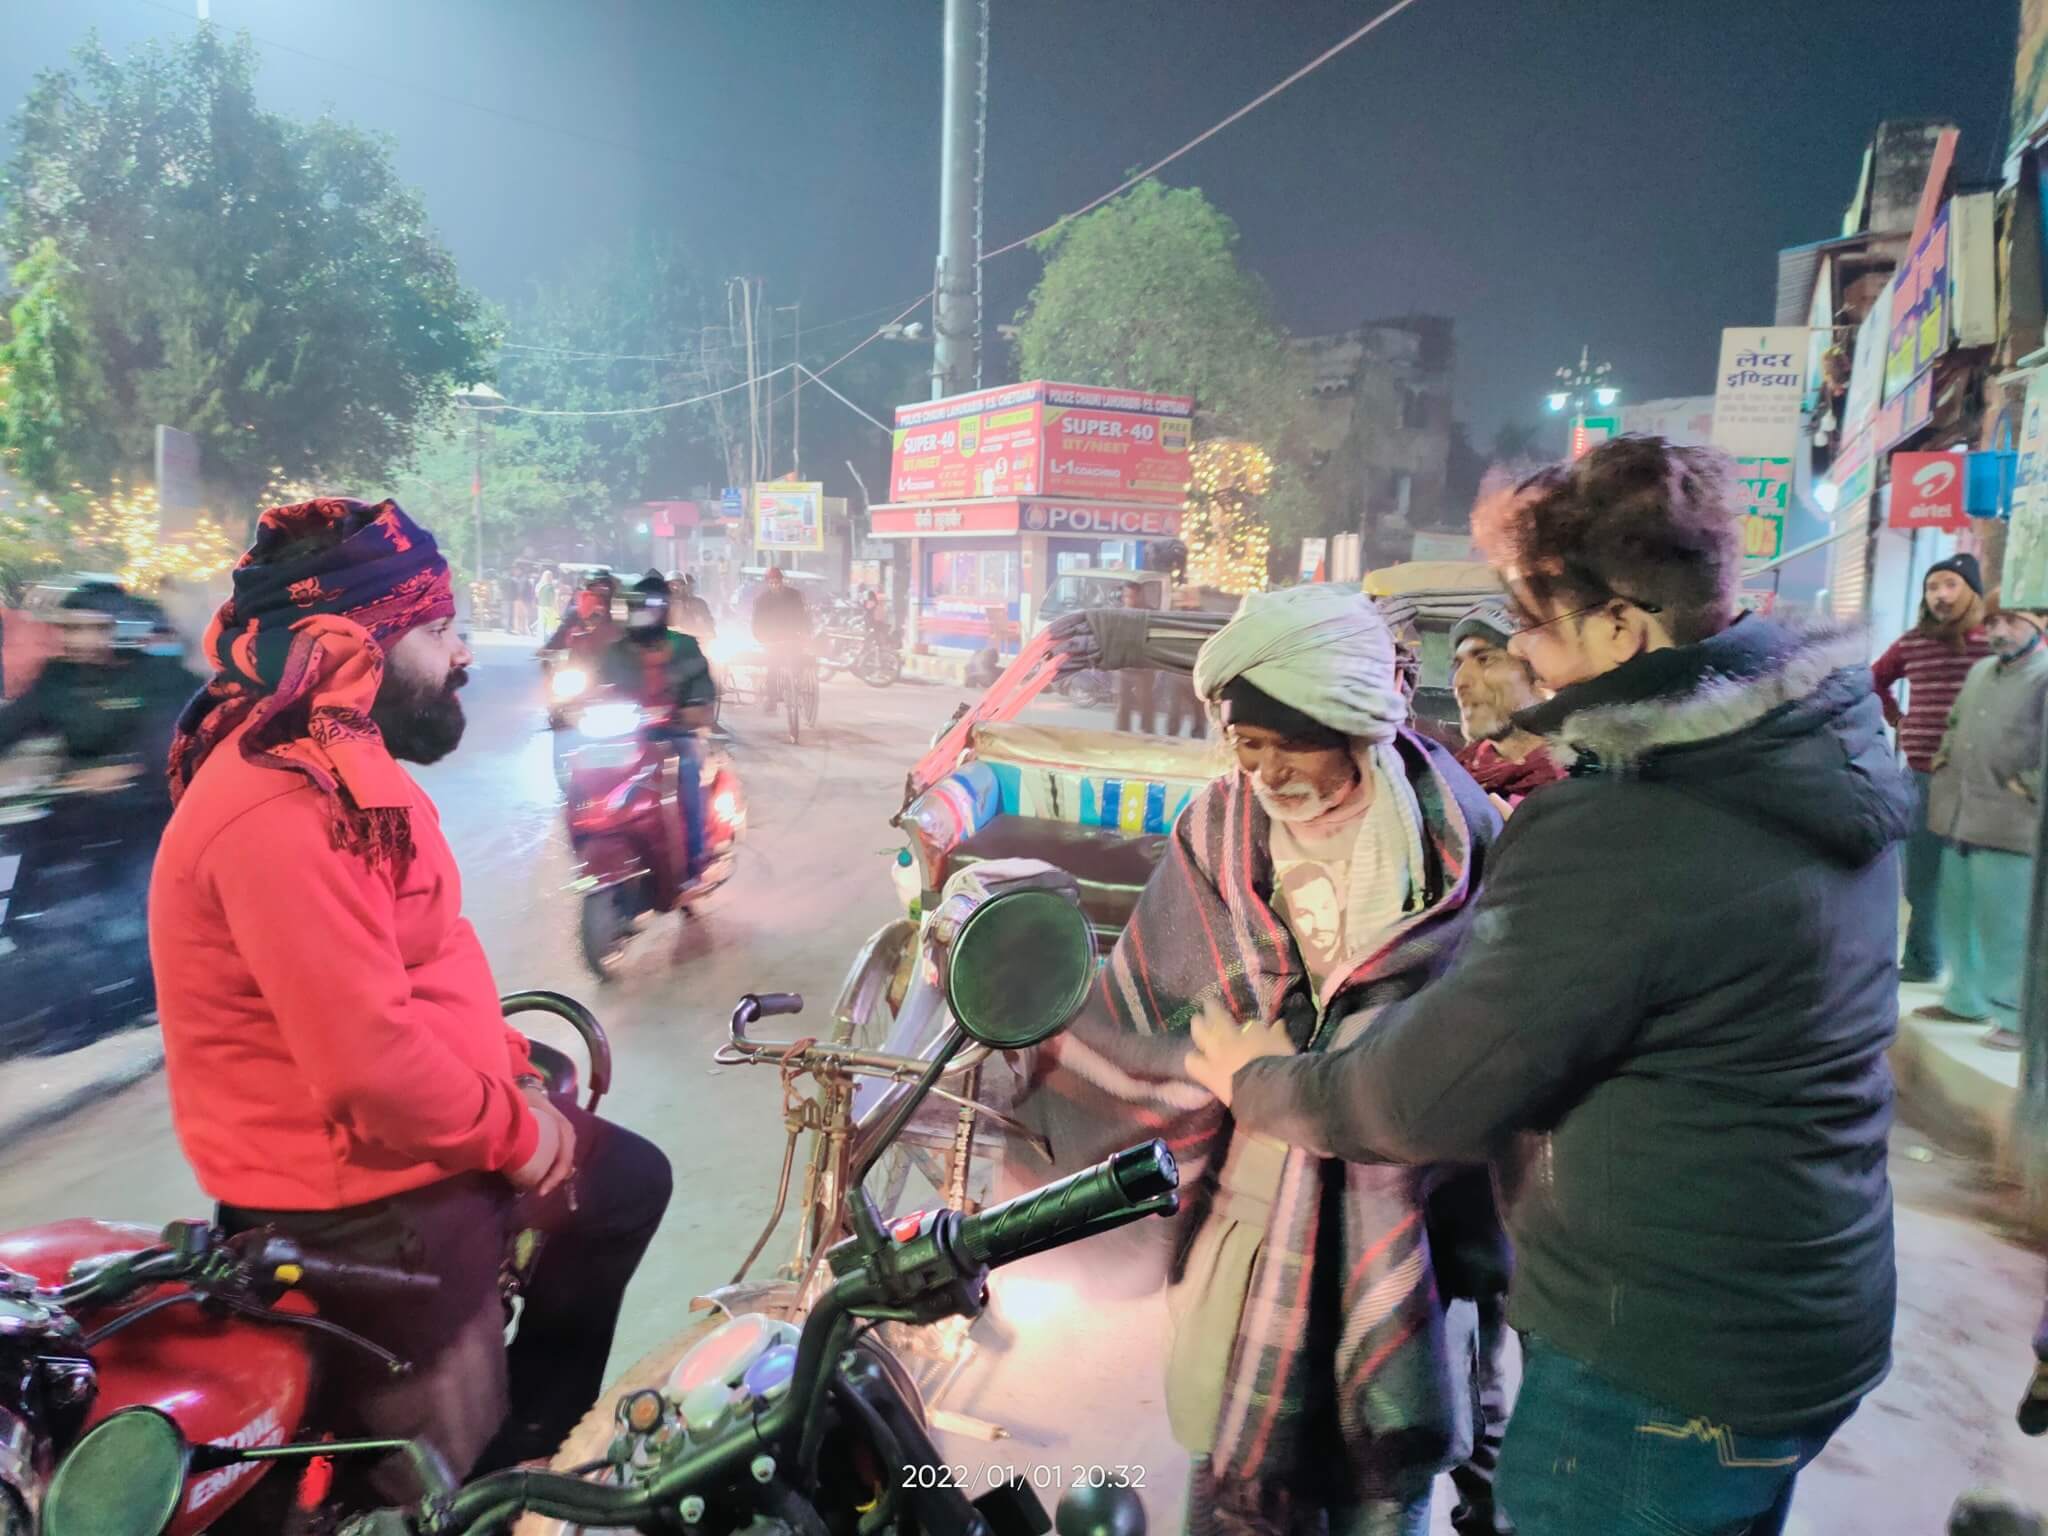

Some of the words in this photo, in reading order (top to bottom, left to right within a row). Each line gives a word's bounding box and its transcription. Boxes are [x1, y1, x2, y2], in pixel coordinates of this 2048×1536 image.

[1735, 348, 1795, 367] लेदर
[1049, 507, 1161, 533] POLICE
[1909, 503, 1953, 518] airtel
